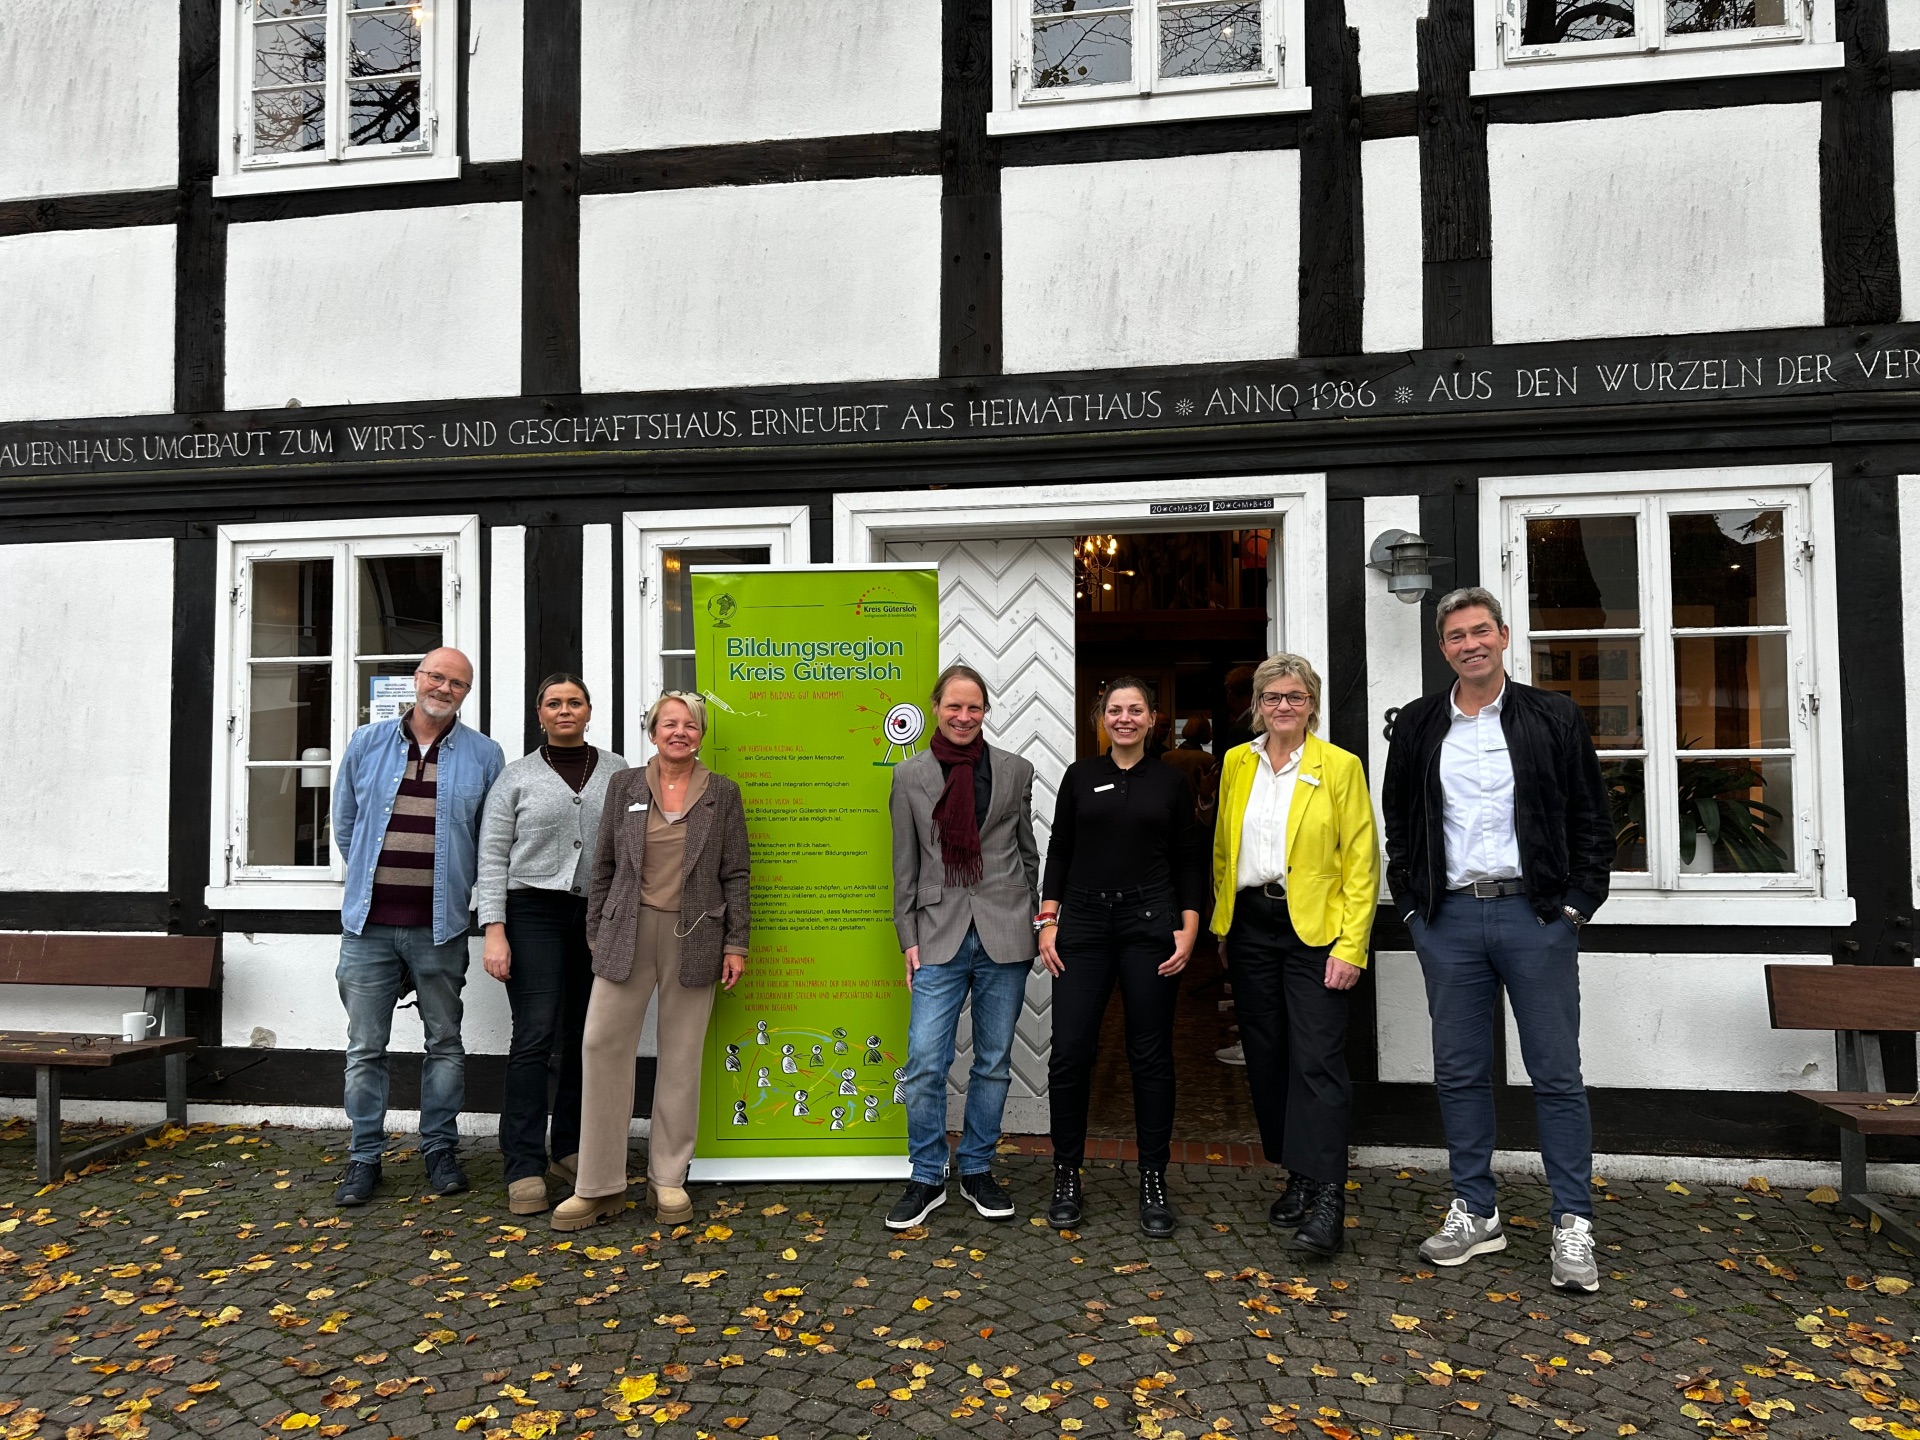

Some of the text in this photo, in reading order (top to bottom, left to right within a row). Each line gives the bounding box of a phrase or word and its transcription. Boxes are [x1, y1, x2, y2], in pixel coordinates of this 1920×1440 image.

[143, 431, 271, 461] UMGEBAUT
[280, 429, 334, 455] ZUM
[509, 410, 742, 446] GESCHÄFTSHAUS,
[750, 404, 888, 437] ERNEUERT
[900, 401, 955, 430] ALS
[968, 390, 1162, 427] HEIMATHAUS
[1204, 383, 1300, 416] ANNO
[1307, 379, 1377, 411] 1986
[1427, 370, 1493, 402] AUS
[1515, 366, 1578, 399] DEN
[1595, 356, 1763, 393] WURZELN
[1777, 353, 1838, 387] DER
[863, 604, 917, 613] Kreis Gütersloh
[726, 636, 904, 662] Bildungsregion
[729, 660, 902, 681] Kreis Gütersloh
[749, 691, 766, 700] DAMIT
[770, 691, 795, 700] BILDUNG
[798, 691, 809, 700] GUT
[782, 956, 815, 964] ÜBERWINDEN
